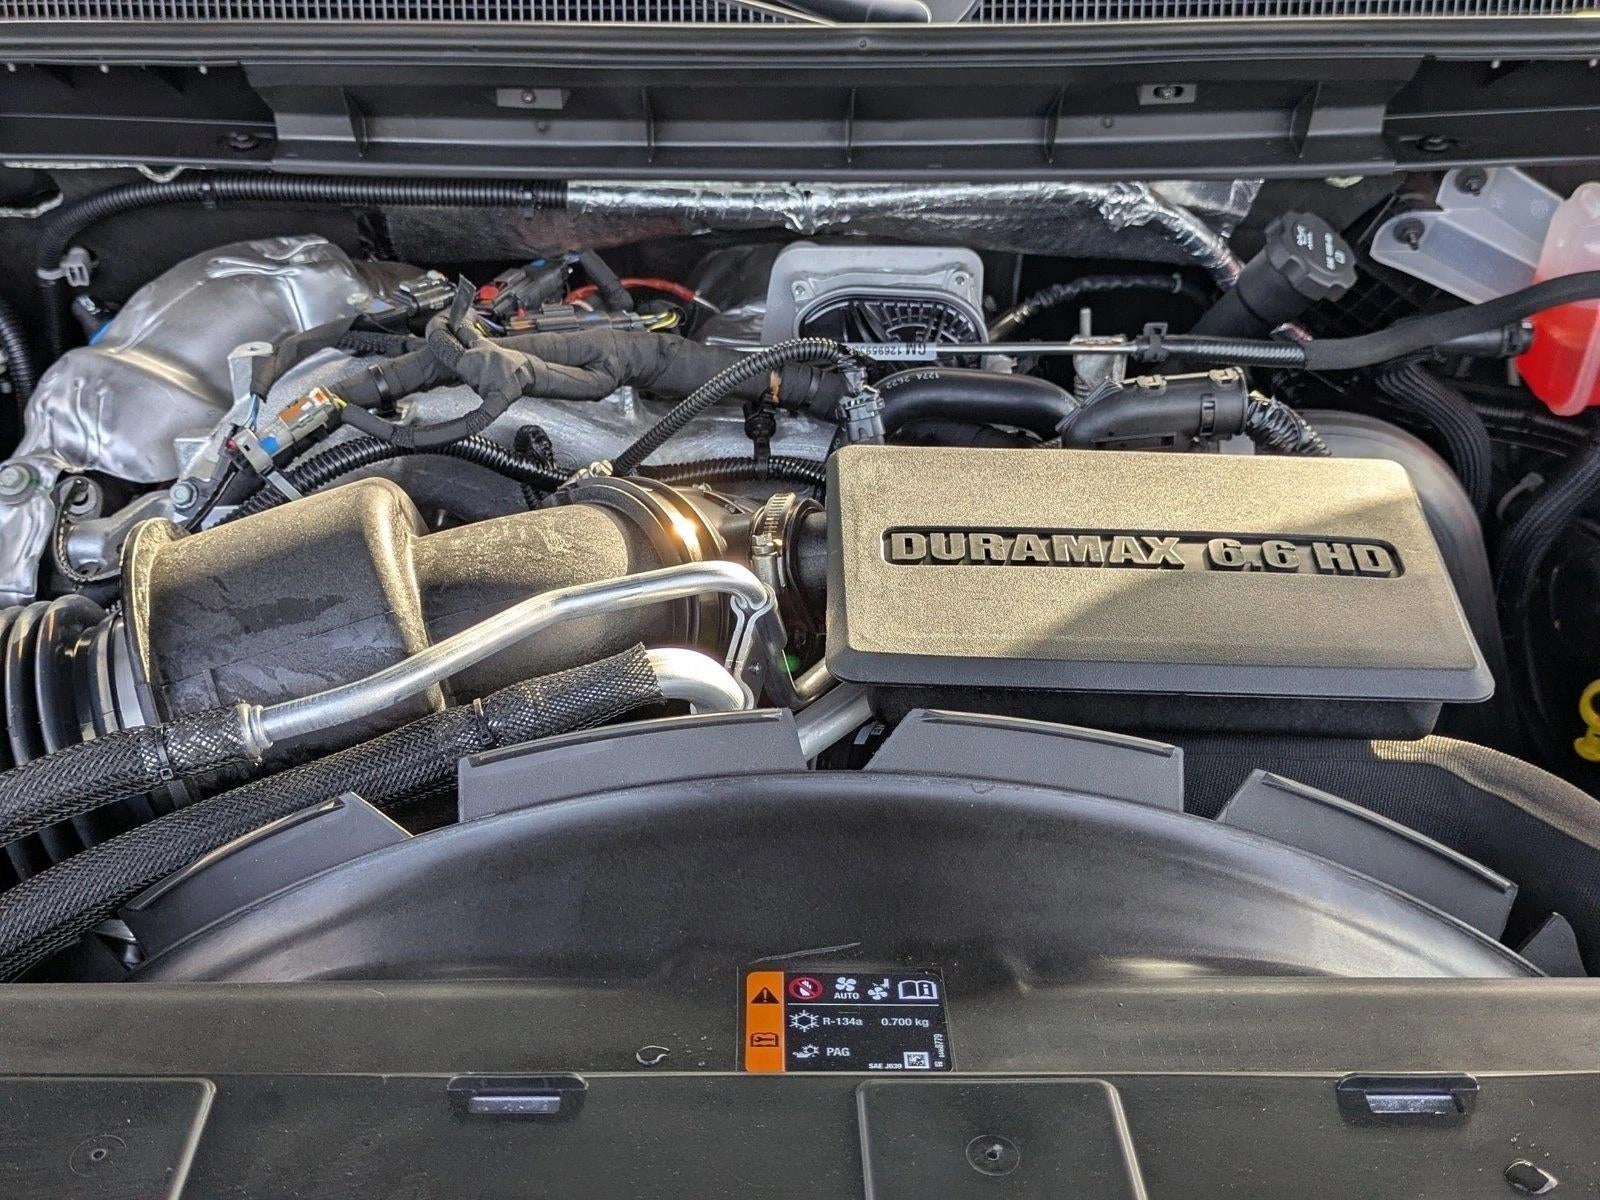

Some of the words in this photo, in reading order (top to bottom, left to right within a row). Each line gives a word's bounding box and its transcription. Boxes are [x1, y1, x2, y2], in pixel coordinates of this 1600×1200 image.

[891, 533, 1185, 569] DURAMAX
[1205, 537, 1302, 573] 6.6
[1315, 543, 1394, 576] HD
[834, 992, 860, 1000] AUTO
[823, 1017, 863, 1026] R-134a
[881, 1017, 912, 1026] 0.700
[915, 1017, 929, 1028] kg
[826, 1048, 850, 1056] PAG
